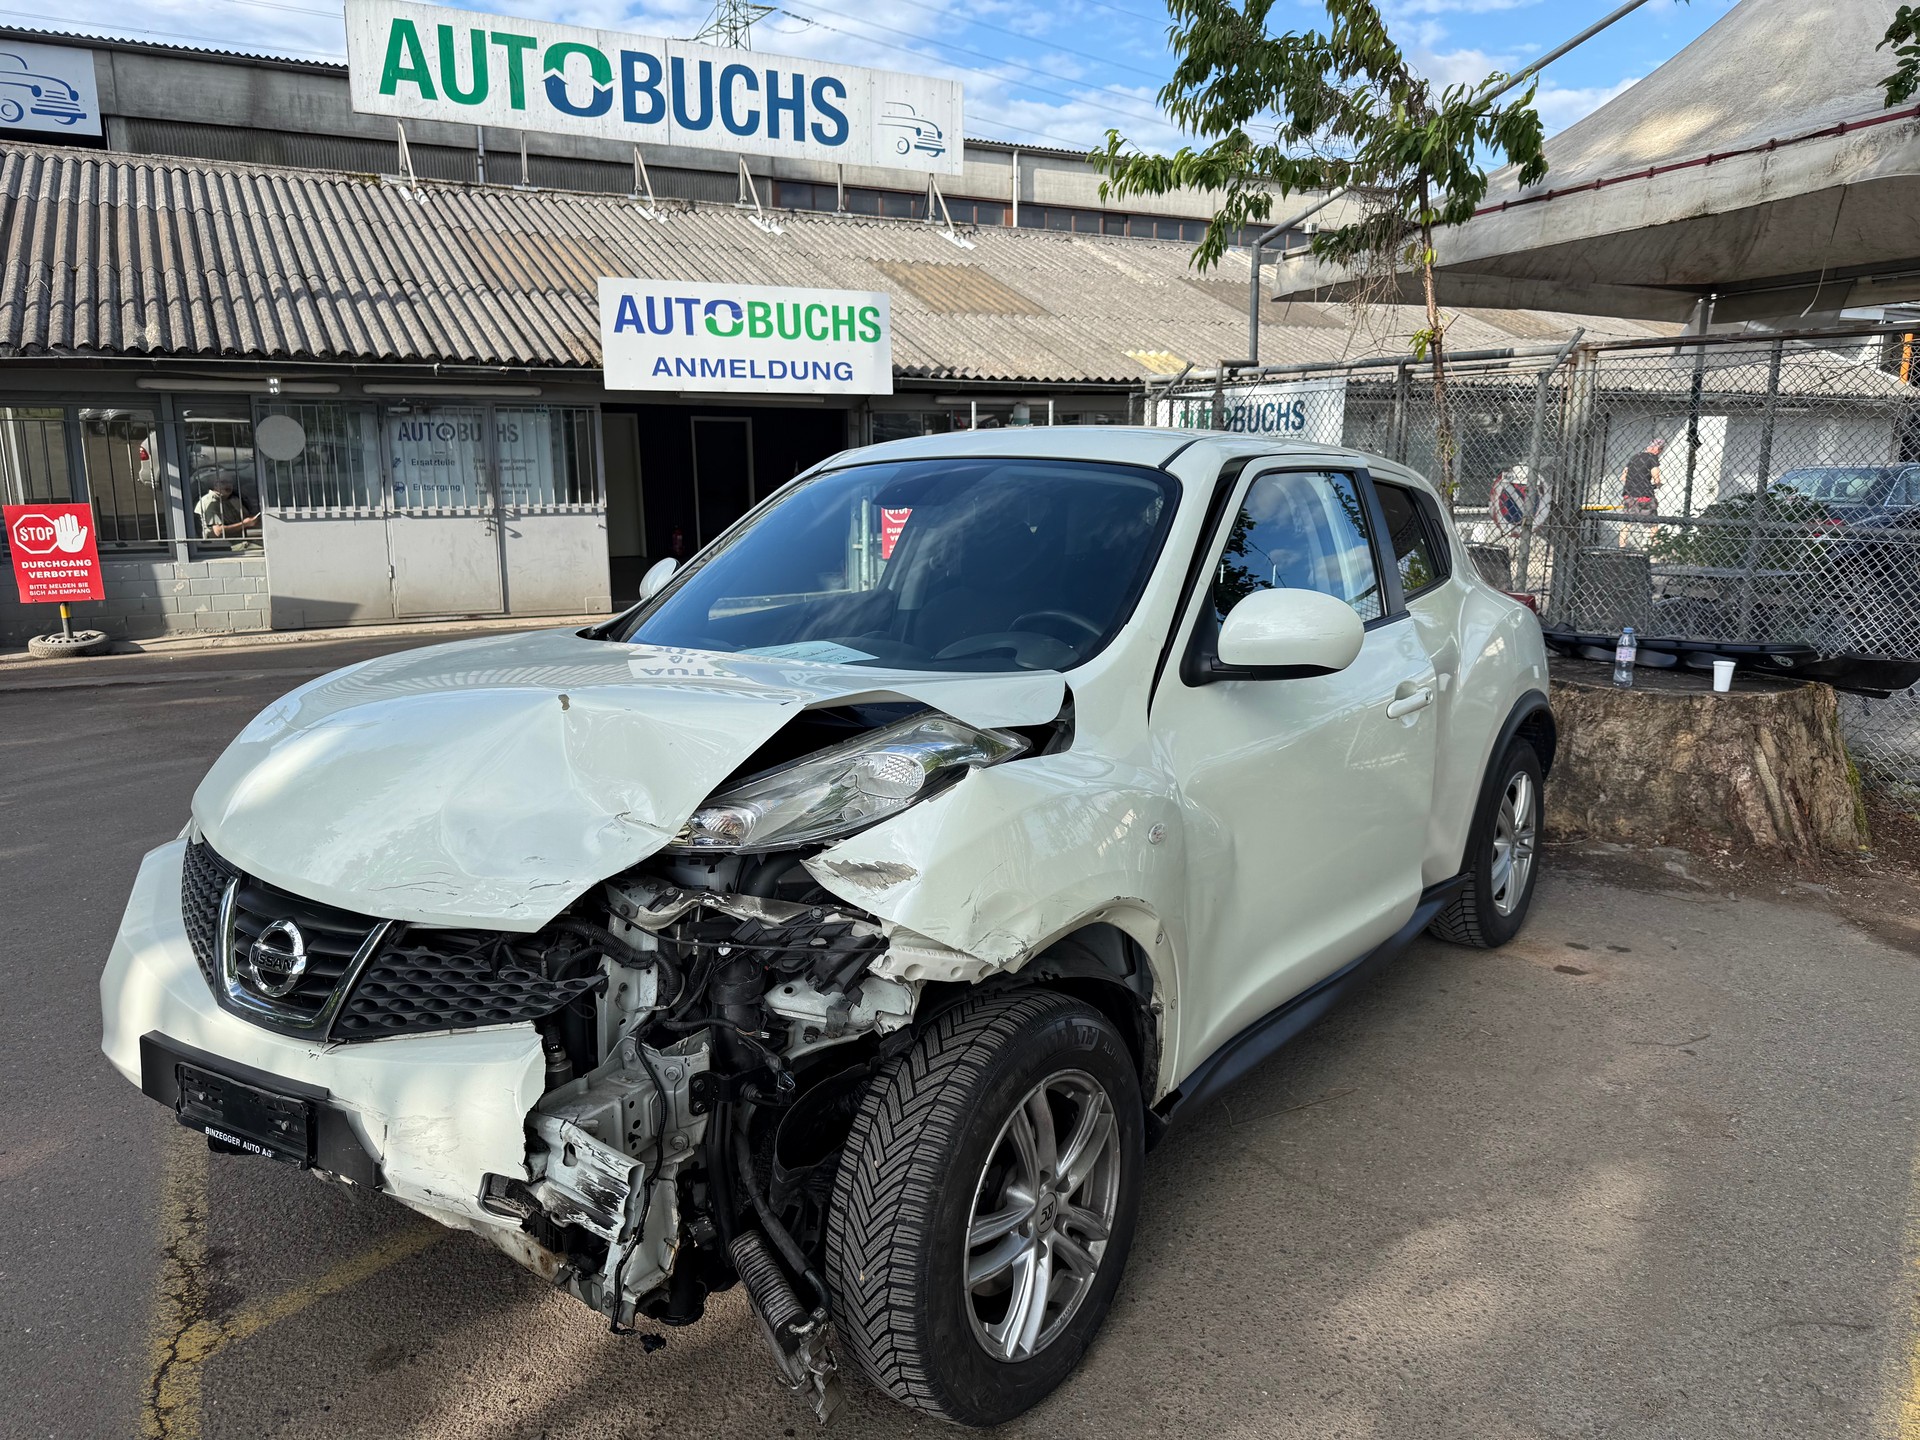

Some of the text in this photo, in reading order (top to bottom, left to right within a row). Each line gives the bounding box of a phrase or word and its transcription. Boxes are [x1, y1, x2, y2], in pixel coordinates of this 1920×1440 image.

[379, 18, 849, 147] AUTOBUCHS
[614, 294, 882, 343] AUTOBUCHS
[652, 357, 853, 381] ANMELDUNG
[19, 527, 54, 541] STOP
[21, 559, 92, 569] DURCHGANG
[28, 570, 88, 579] VERBOTEN
[250, 949, 295, 970] NISSAN
[205, 1126, 272, 1158] BINZEGGER AUTO AG
